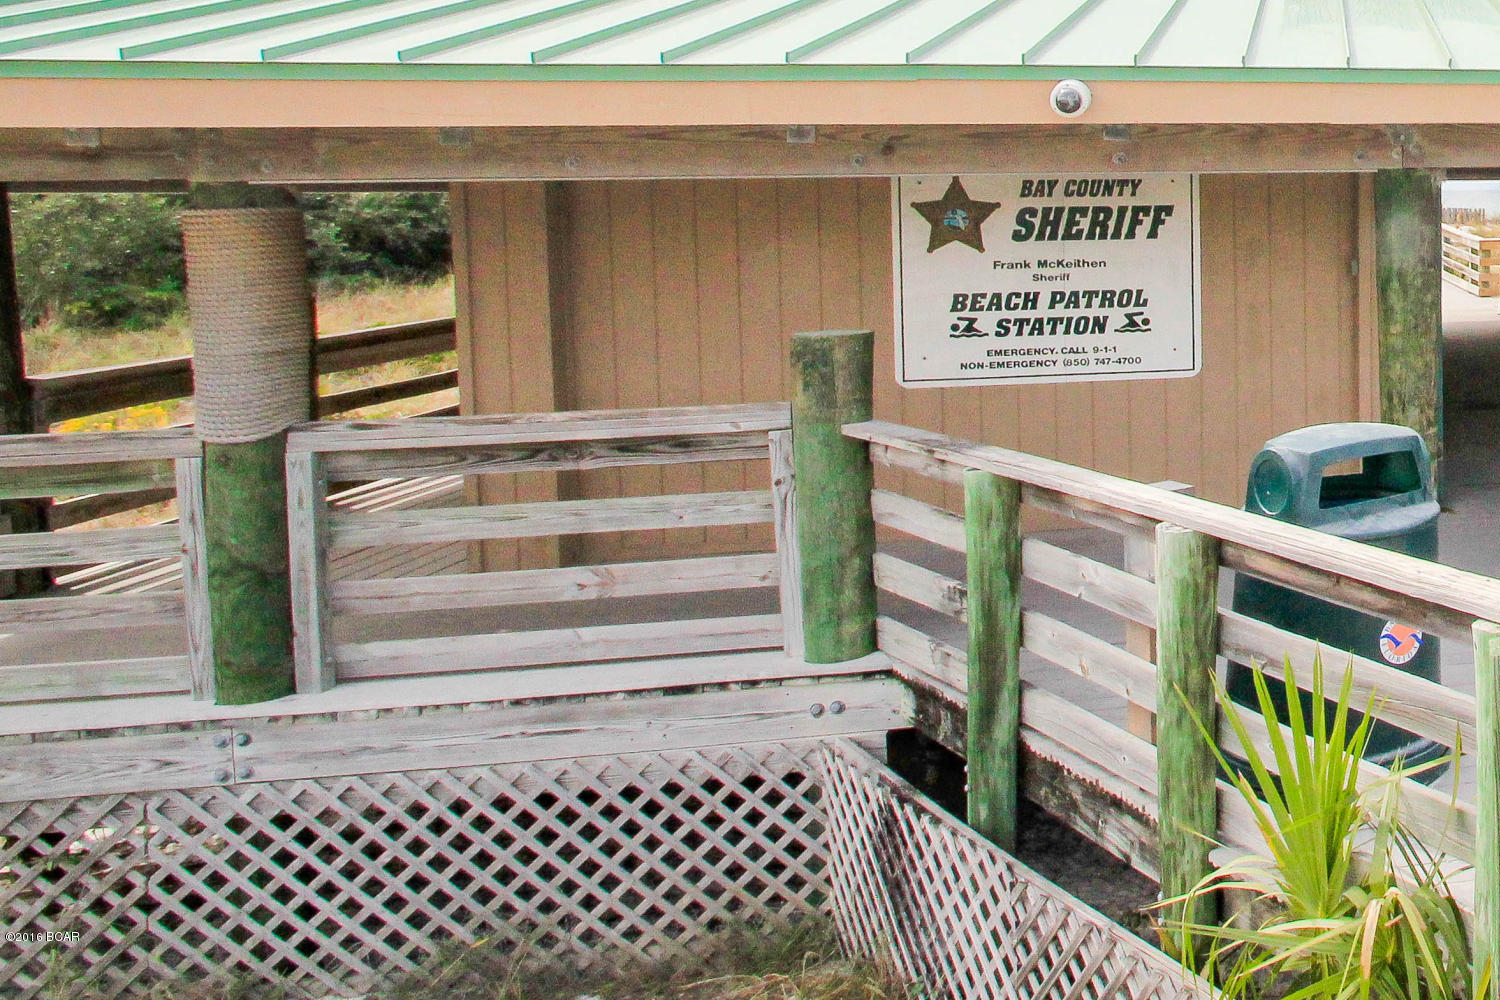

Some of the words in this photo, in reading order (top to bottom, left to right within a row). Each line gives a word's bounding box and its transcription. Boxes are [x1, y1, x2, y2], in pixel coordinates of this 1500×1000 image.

[1019, 179, 1059, 198] BAY
[1064, 179, 1142, 198] COUNTY
[1011, 205, 1175, 242] SHERIFF
[993, 260, 1031, 270] Frank
[1037, 258, 1107, 269] McKeithen
[1032, 273, 1071, 282] Sheriff
[950, 292, 1040, 313] BEACH
[1048, 288, 1148, 310] PATROL
[994, 315, 1109, 338] STATION
[1061, 346, 1088, 355] CALL
[1092, 345, 1118, 354] 9-1-1
[960, 359, 1058, 371] NON-EMERGENCY
[1062, 357, 1090, 368] (850)
[1094, 356, 1142, 367] 747-4700
